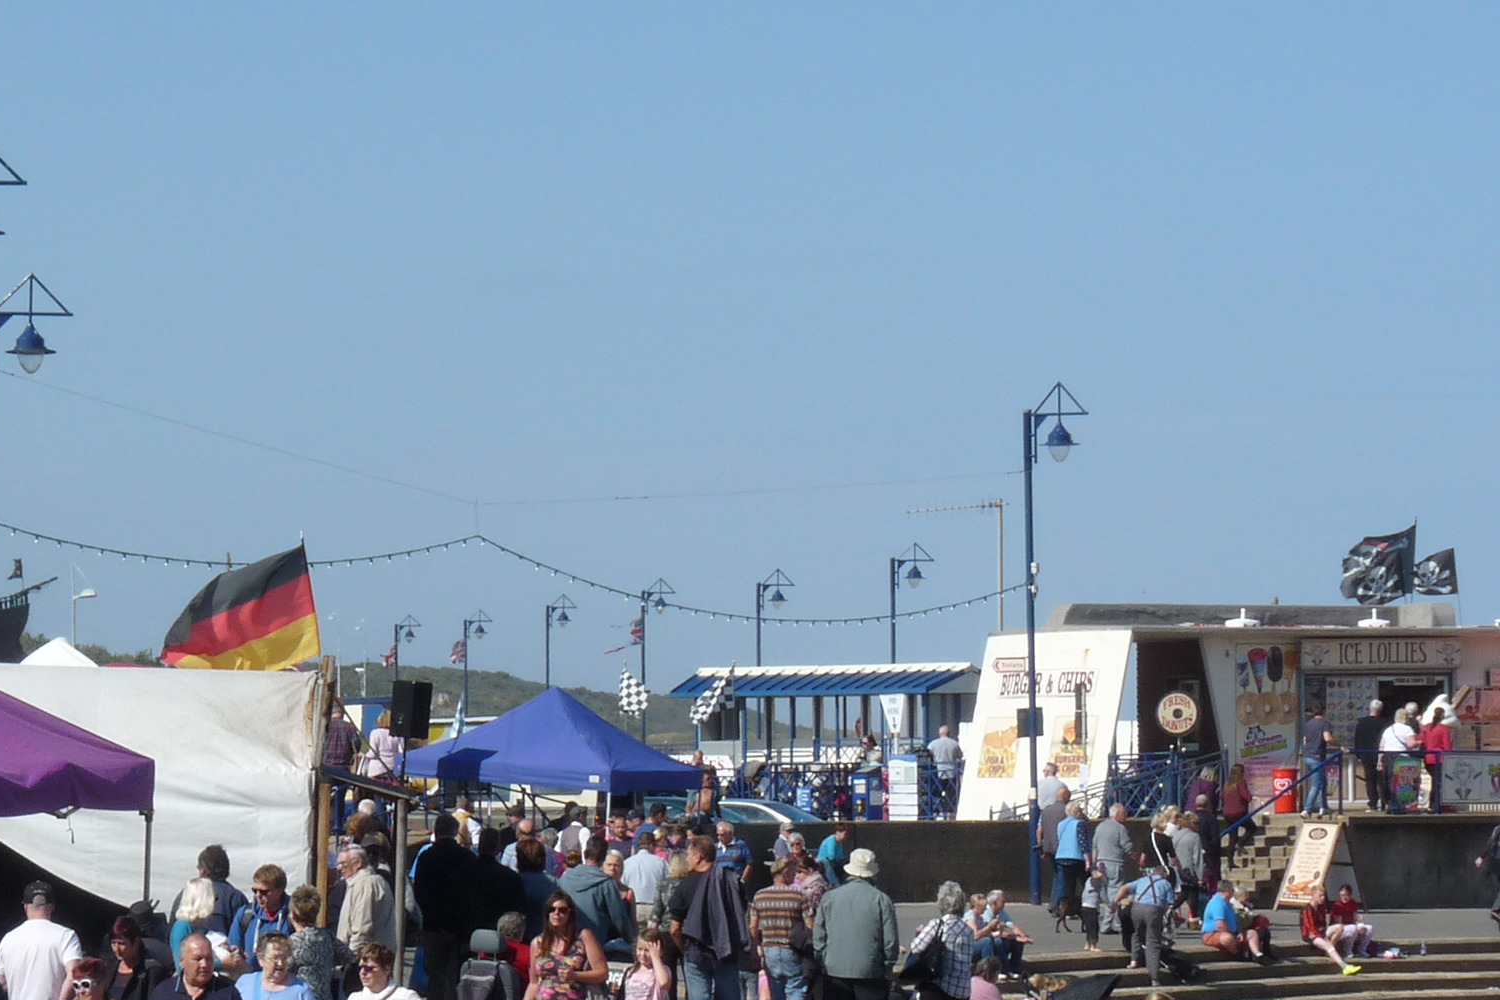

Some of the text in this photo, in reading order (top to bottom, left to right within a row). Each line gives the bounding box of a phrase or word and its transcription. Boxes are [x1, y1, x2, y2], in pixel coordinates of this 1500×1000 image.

[1338, 642, 1427, 664] ICE LOLLIES
[1046, 675, 1053, 694] &
[1163, 696, 1191, 710] FRESH
[1161, 713, 1194, 731] DONUTS
